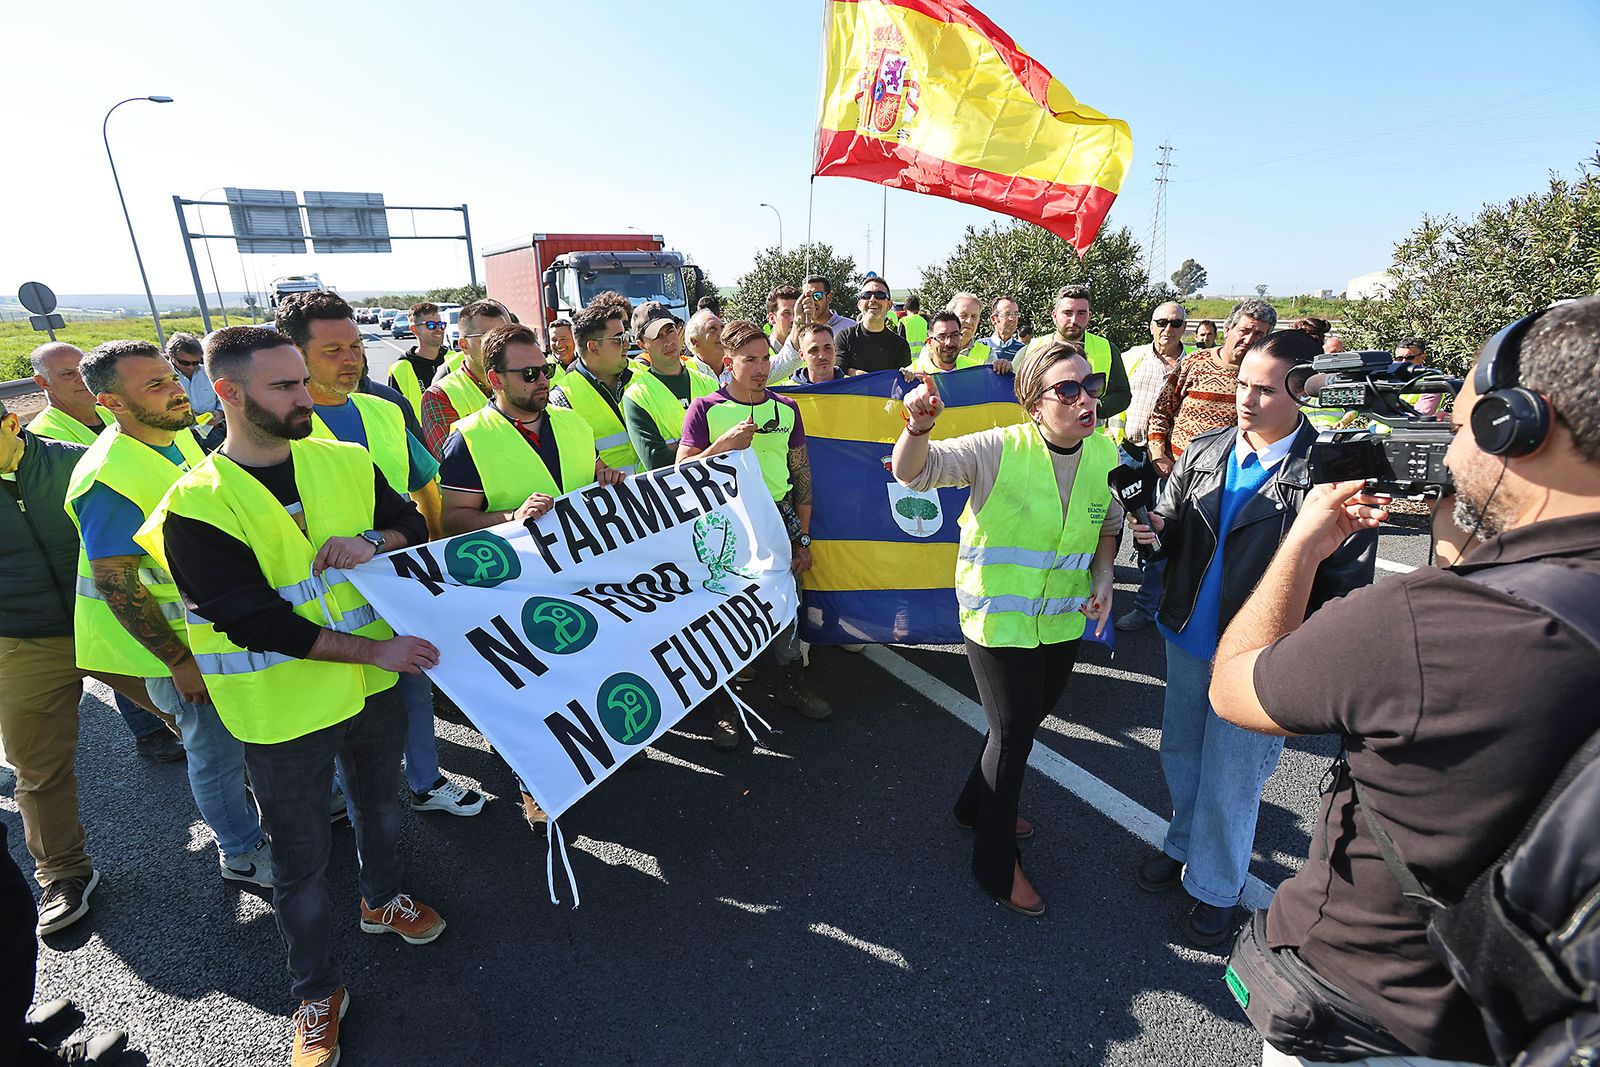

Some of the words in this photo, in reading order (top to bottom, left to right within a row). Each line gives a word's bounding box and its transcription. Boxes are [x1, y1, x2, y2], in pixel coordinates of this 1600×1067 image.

[523, 455, 739, 574] FARMERS
[571, 562, 693, 623] FOOD
[650, 584, 780, 709] FUTURE
